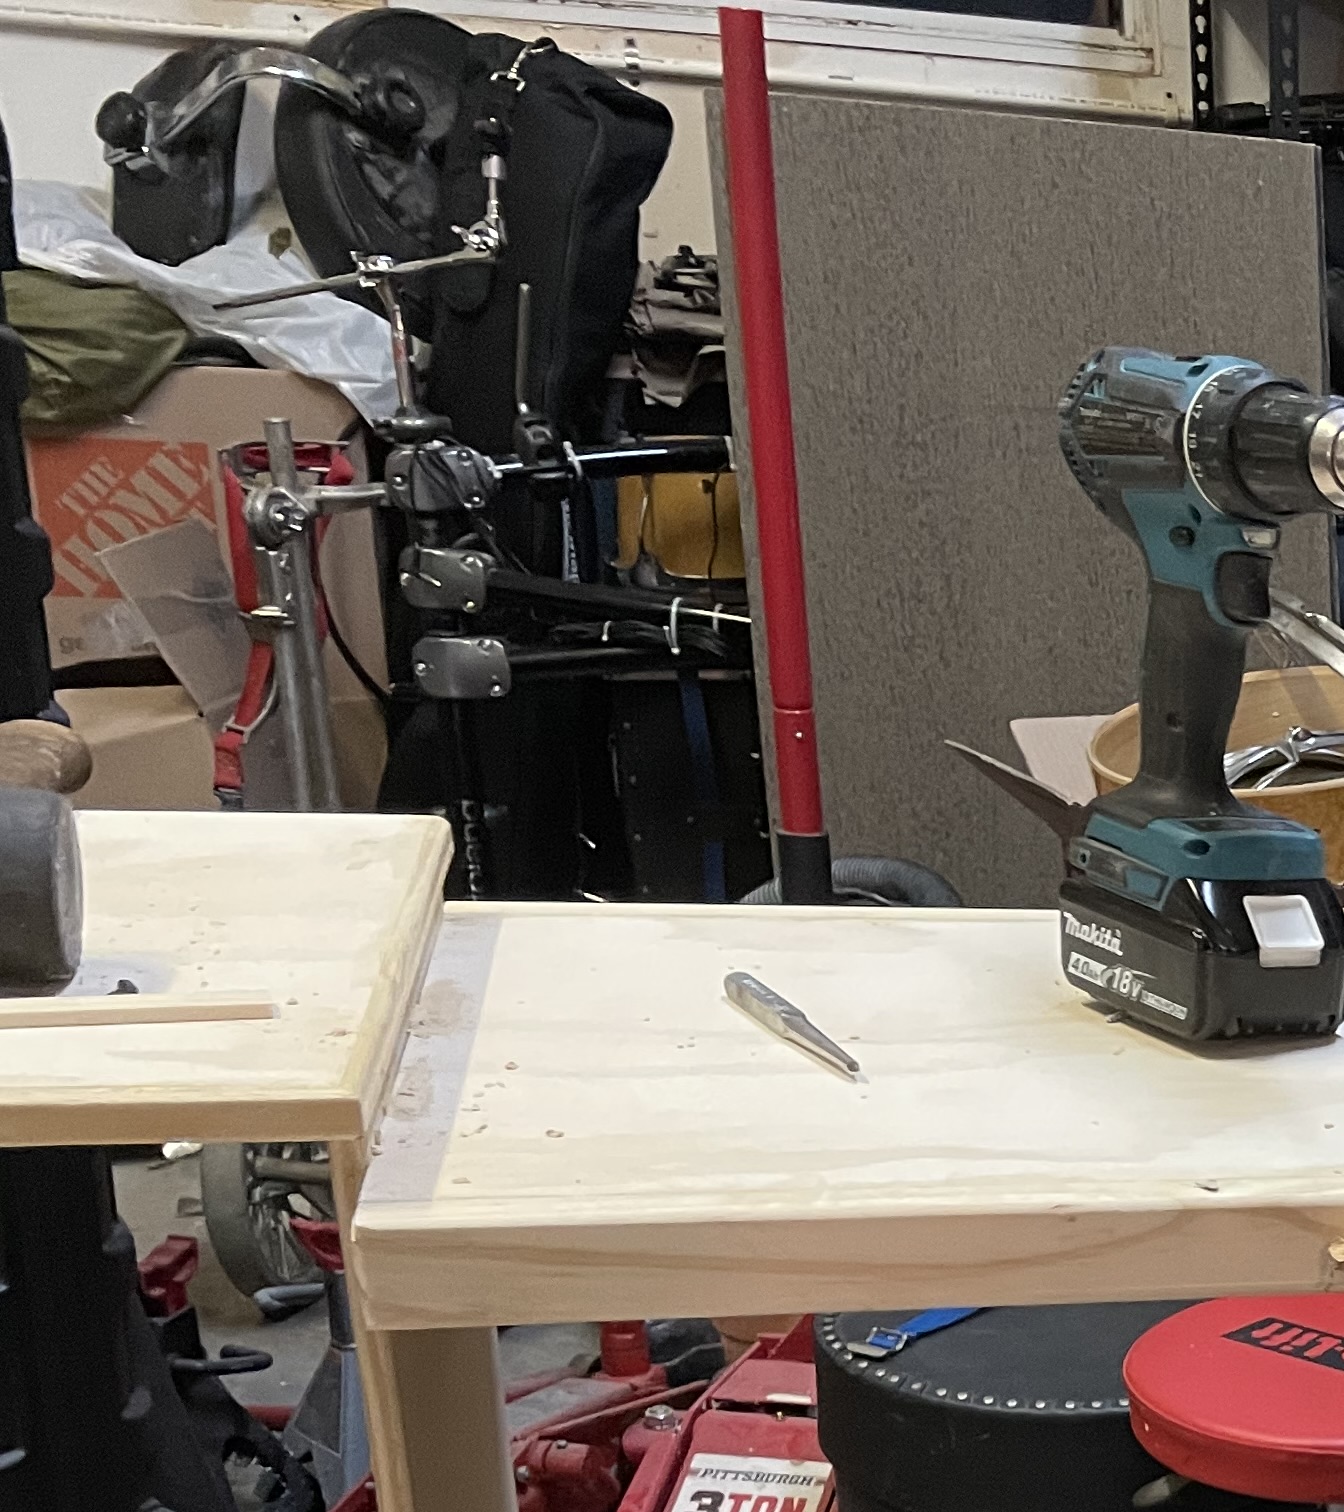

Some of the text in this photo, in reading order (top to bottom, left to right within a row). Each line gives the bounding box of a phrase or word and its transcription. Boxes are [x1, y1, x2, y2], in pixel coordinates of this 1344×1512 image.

[56, 455, 123, 515] THE
[1063, 911, 1123, 956] makita
[699, 1468, 815, 1487] PITTSBURGH
